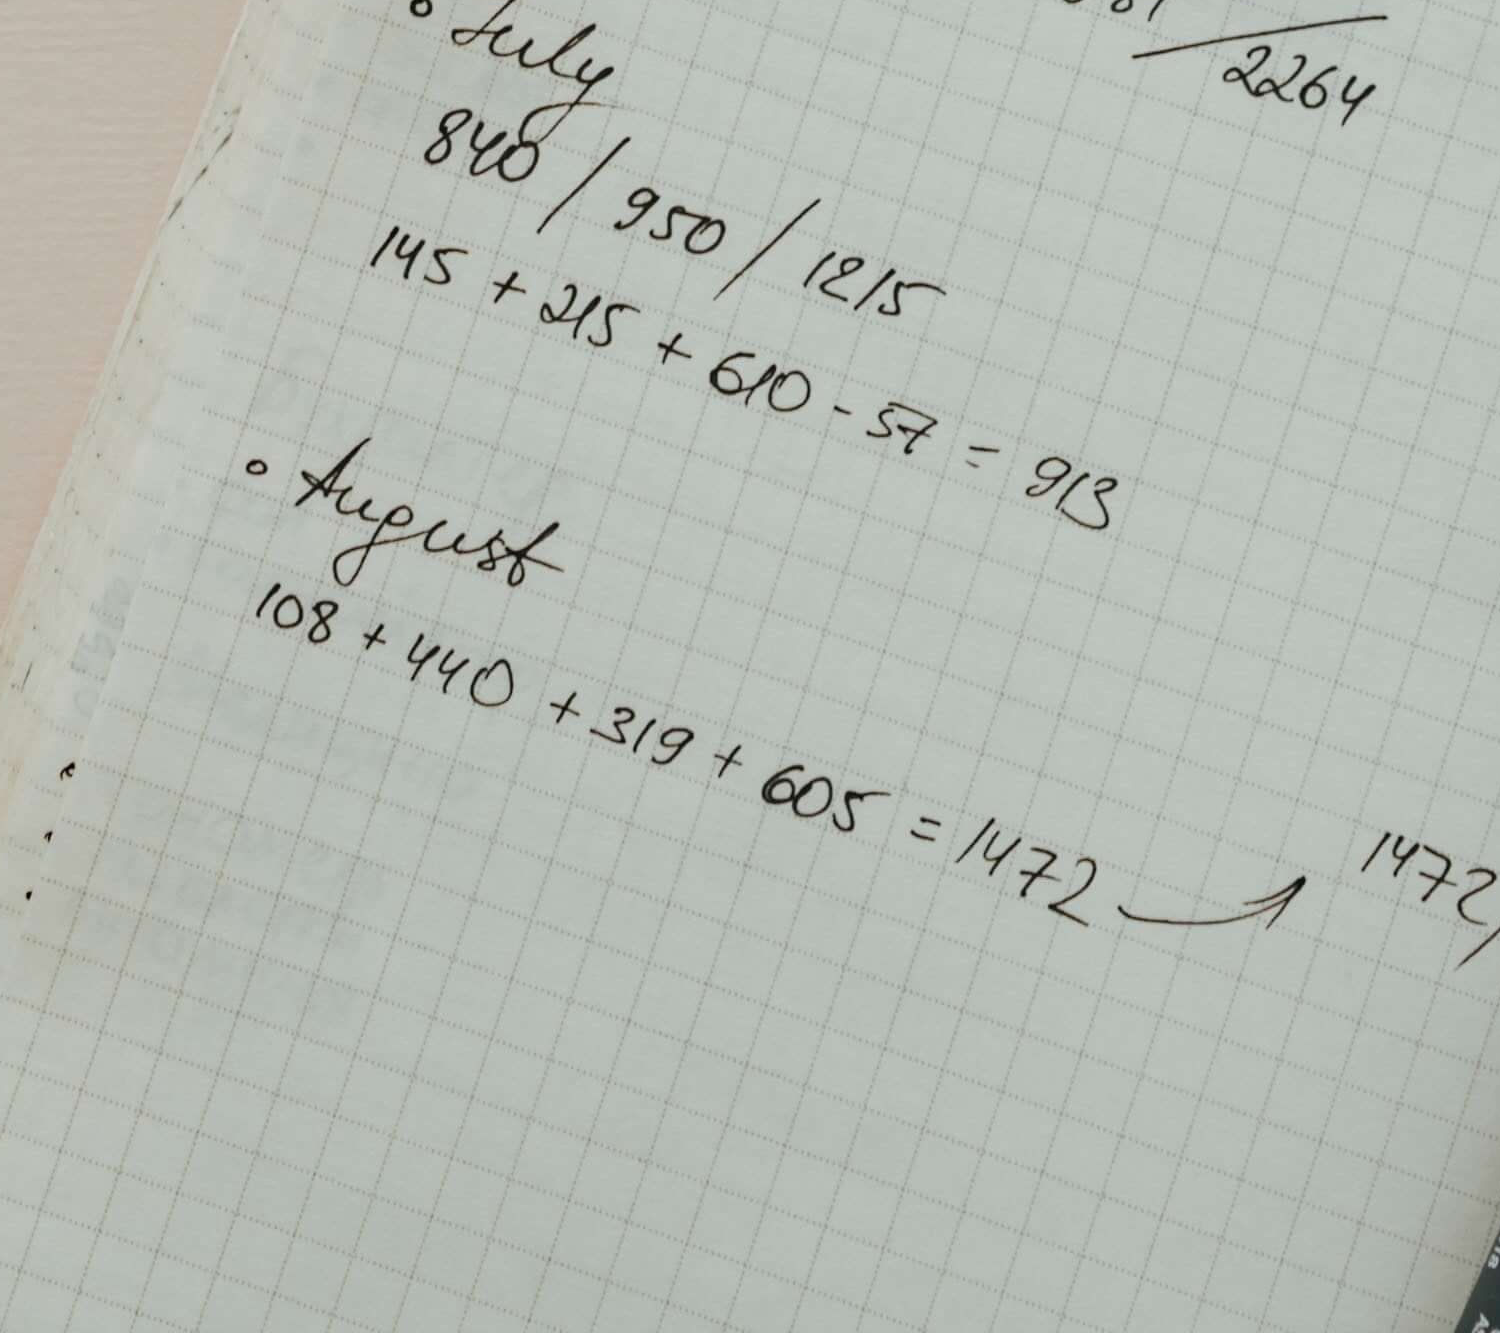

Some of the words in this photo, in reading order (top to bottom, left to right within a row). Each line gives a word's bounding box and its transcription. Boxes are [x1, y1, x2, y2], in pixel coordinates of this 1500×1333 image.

[1223, 44, 1376, 124] 2264
[425, 110, 540, 181] 840
[613, 187, 726, 255] 950
[805, 251, 945, 316] 1215
[369, 225, 469, 286] 145
[539, 283, 641, 348] 215
[709, 351, 812, 413] 610
[865, 401, 939, 456] 57
[1024, 456, 1119, 531] 913
[295, 438, 564, 588] August
[255, 582, 338, 645] 108
[407, 632, 514, 708] 440
[589, 706, 695, 766] 319
[761, 764, 891, 833] 605
[954, 817, 1098, 927] 1472
